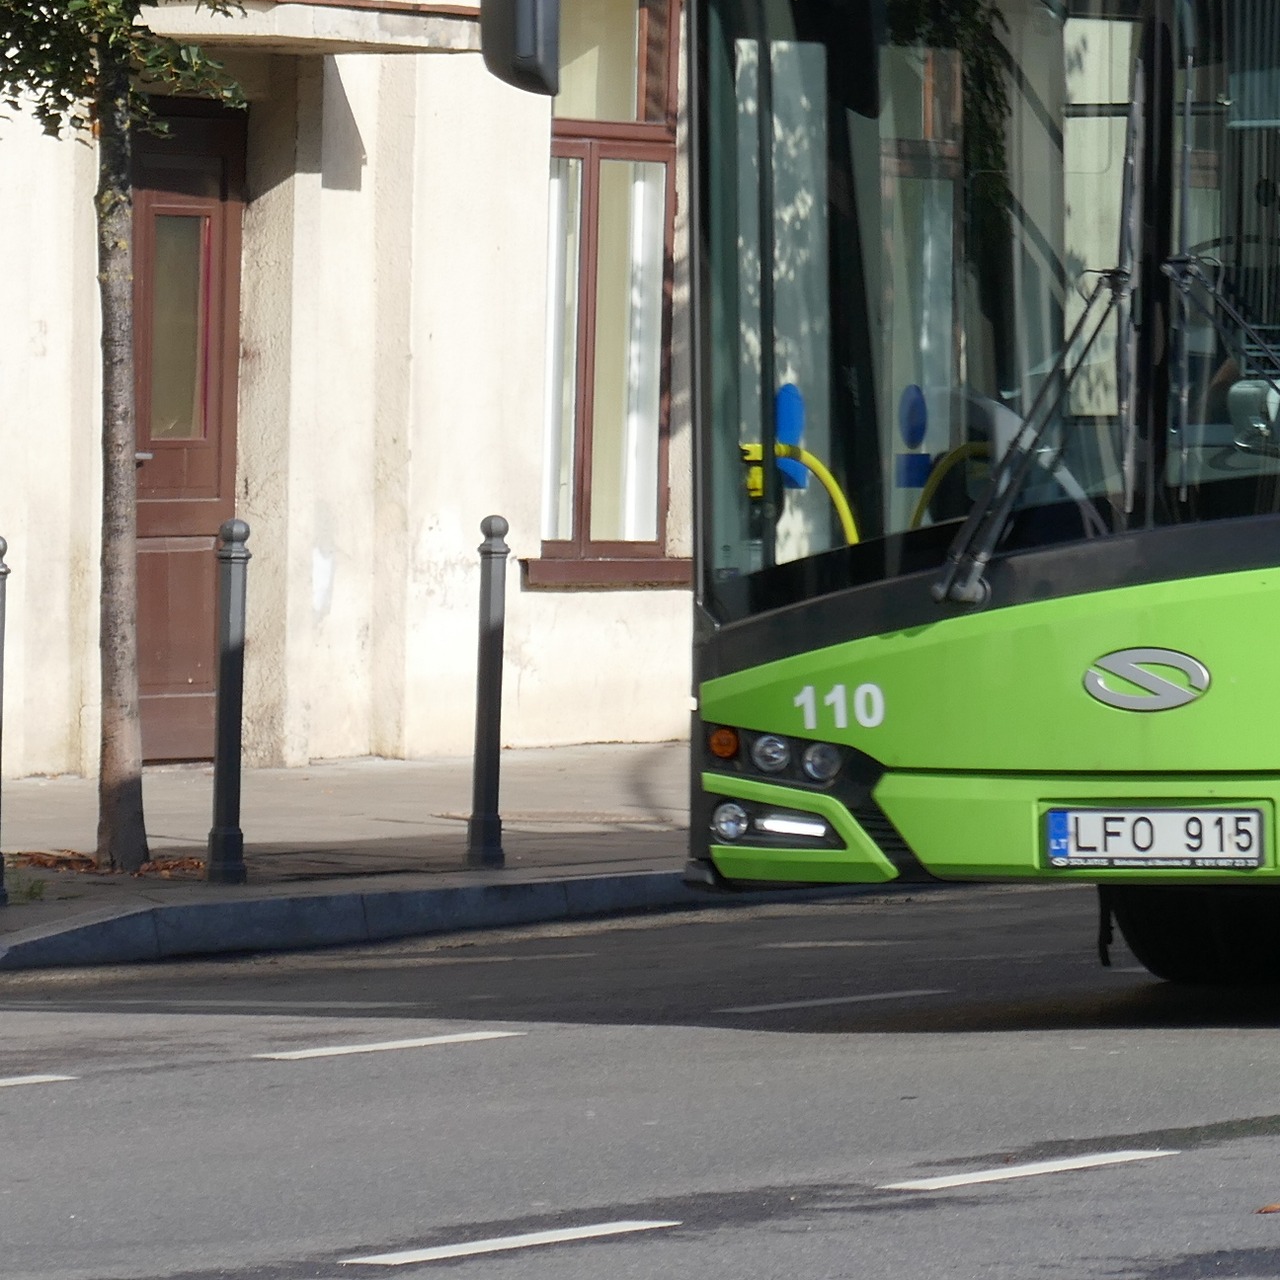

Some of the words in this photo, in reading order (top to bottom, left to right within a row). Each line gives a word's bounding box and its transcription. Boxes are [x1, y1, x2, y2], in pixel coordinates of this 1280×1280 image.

[793, 683, 885, 730] 110
[1051, 839, 1067, 850] LT
[1074, 816, 1154, 852] LFO
[1185, 816, 1253, 852] 915
